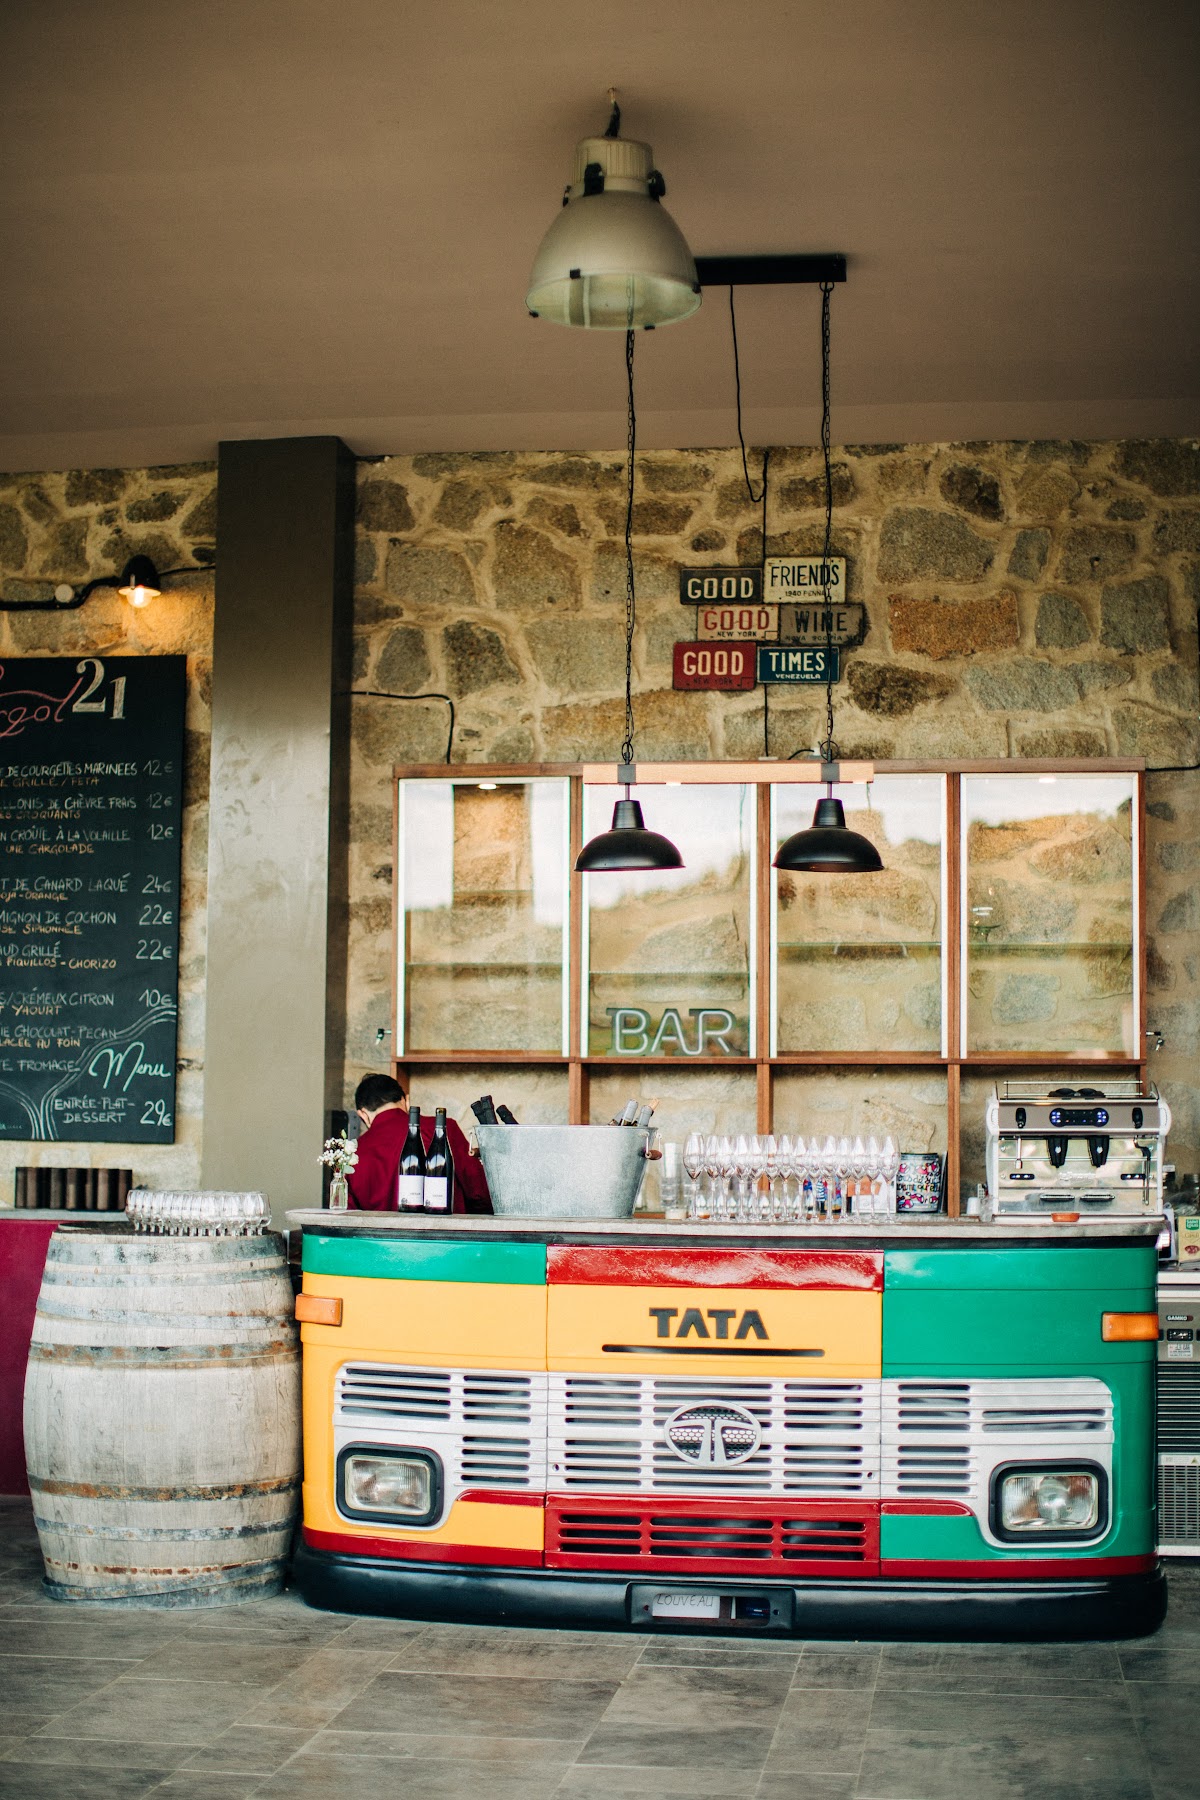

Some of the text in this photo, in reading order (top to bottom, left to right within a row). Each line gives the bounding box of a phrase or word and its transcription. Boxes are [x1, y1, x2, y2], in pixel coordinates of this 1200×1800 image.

[771, 564, 840, 587] FRIENDS
[687, 577, 754, 599] GOOD
[703, 610, 770, 631] GOOD
[794, 610, 847, 633] WINE
[683, 651, 744, 676] GOOD
[768, 652, 826, 672] TIMES
[71, 658, 127, 720] 21
[5, 765, 19, 779] DE
[109, 797, 137, 810] FRAIS
[67, 832, 80, 842] LA
[145, 823, 174, 842] 12€
[28, 843, 95, 856] CARGOLADE
[12, 878, 29, 892] DE
[34, 876, 83, 893] CANARD
[88, 872, 131, 893] LAQUÉ
[45, 911, 62, 925] DE
[65, 911, 117, 926] COCHON
[139, 904, 173, 926] 22€
[22, 941, 61, 958] GRILLÉ
[136, 939, 173, 961] 22€
[68, 958, 117, 970] CHORIZO
[139, 989, 173, 1008] 10€
[11, 1004, 62, 1017] YAOURT
[606, 1007, 742, 1056] BAR
[36, 1037, 50, 1049] AU
[57, 1036, 81, 1047] FOIN
[17, 1060, 81, 1073] FROMAGE
[88, 1041, 172, 1092] Menu
[62, 1112, 127, 1124] DESSERT
[140, 1099, 173, 1127] 29€
[649, 1307, 770, 1340] TATA
